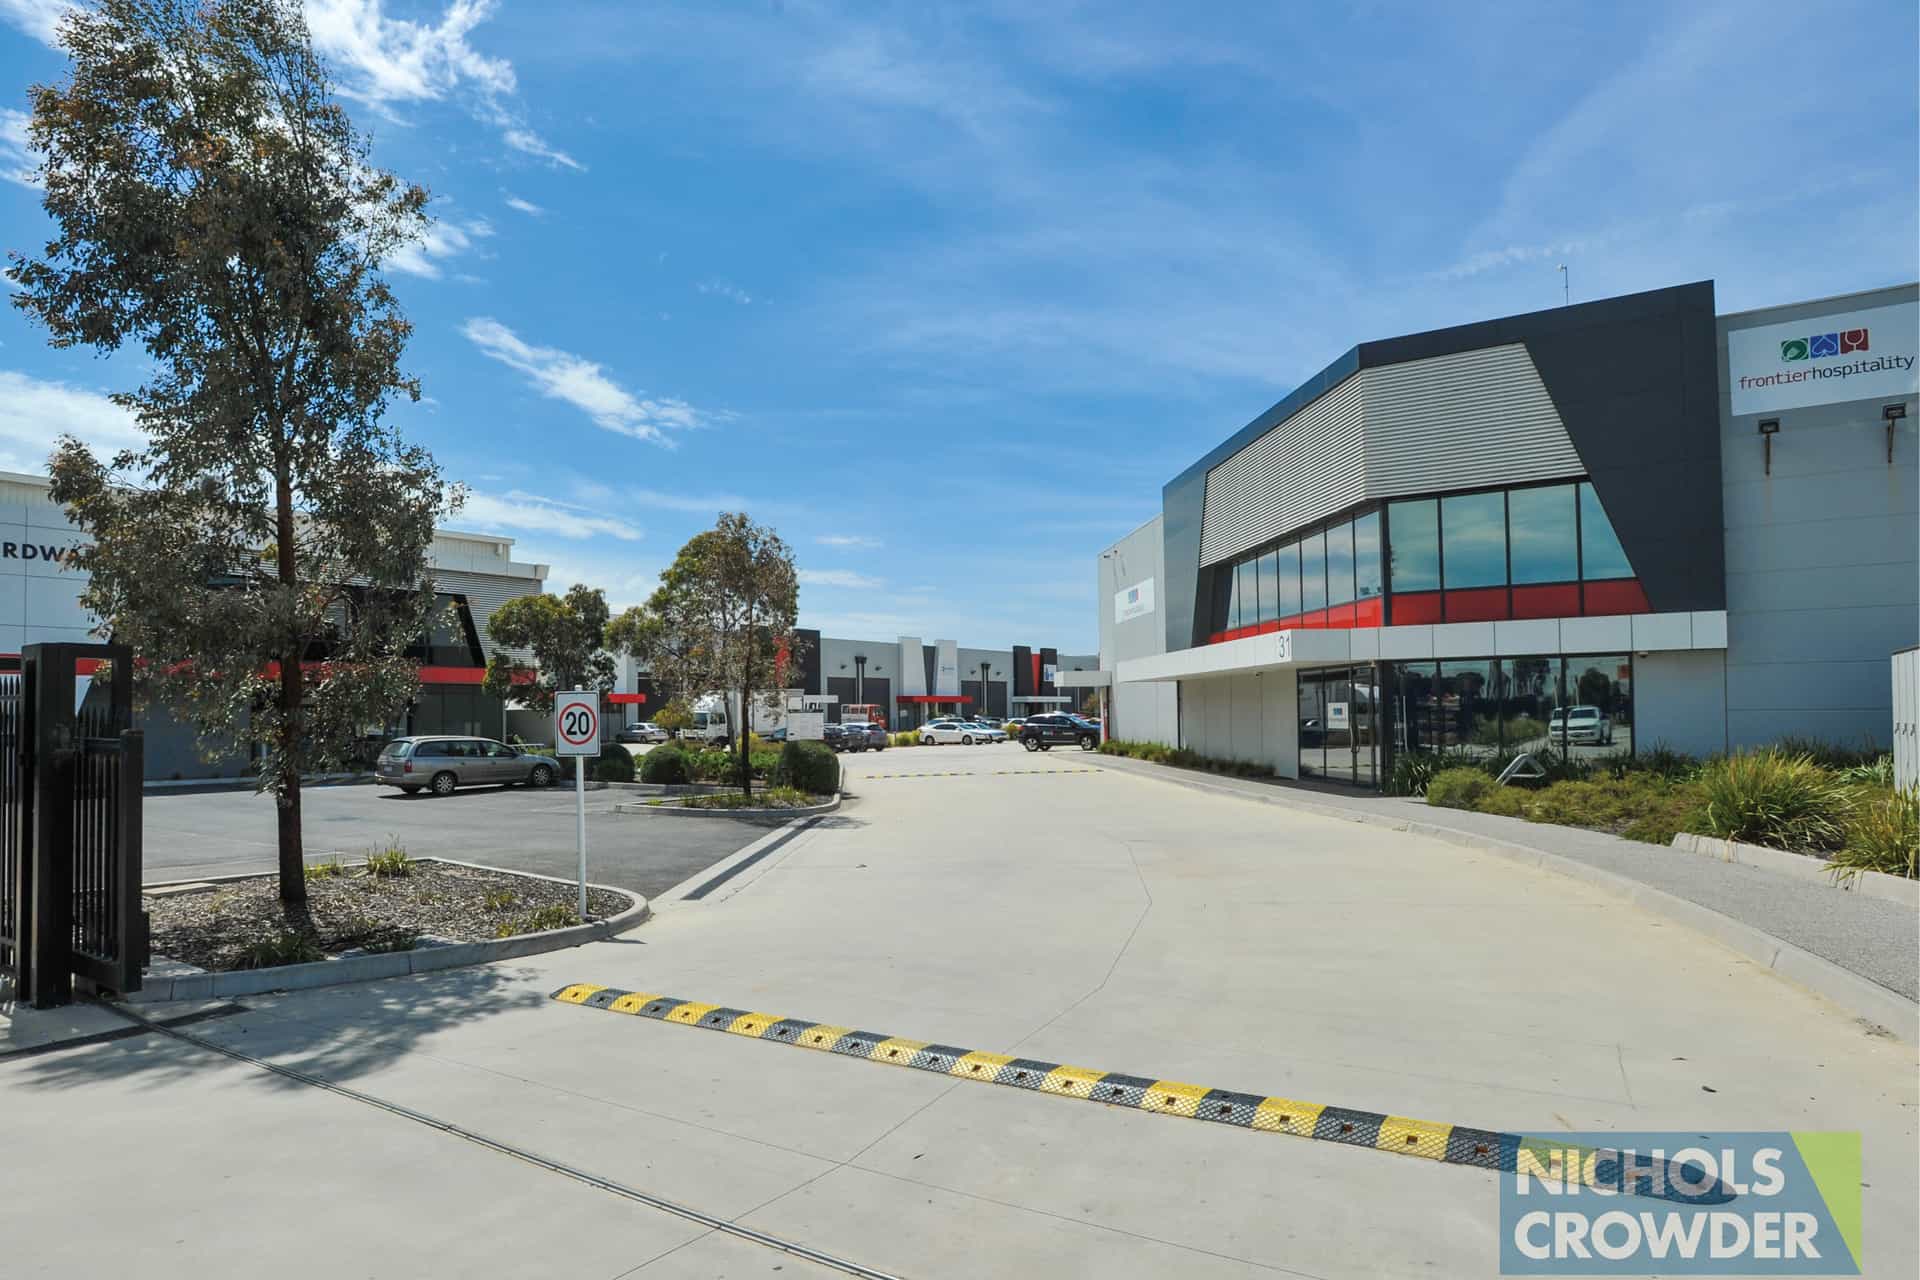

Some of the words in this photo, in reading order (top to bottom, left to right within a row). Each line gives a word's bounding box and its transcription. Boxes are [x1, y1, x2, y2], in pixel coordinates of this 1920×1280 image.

[1738, 355, 1915, 389] frontierhospitality
[1279, 636, 1291, 658] 31
[565, 711, 590, 736] 20
